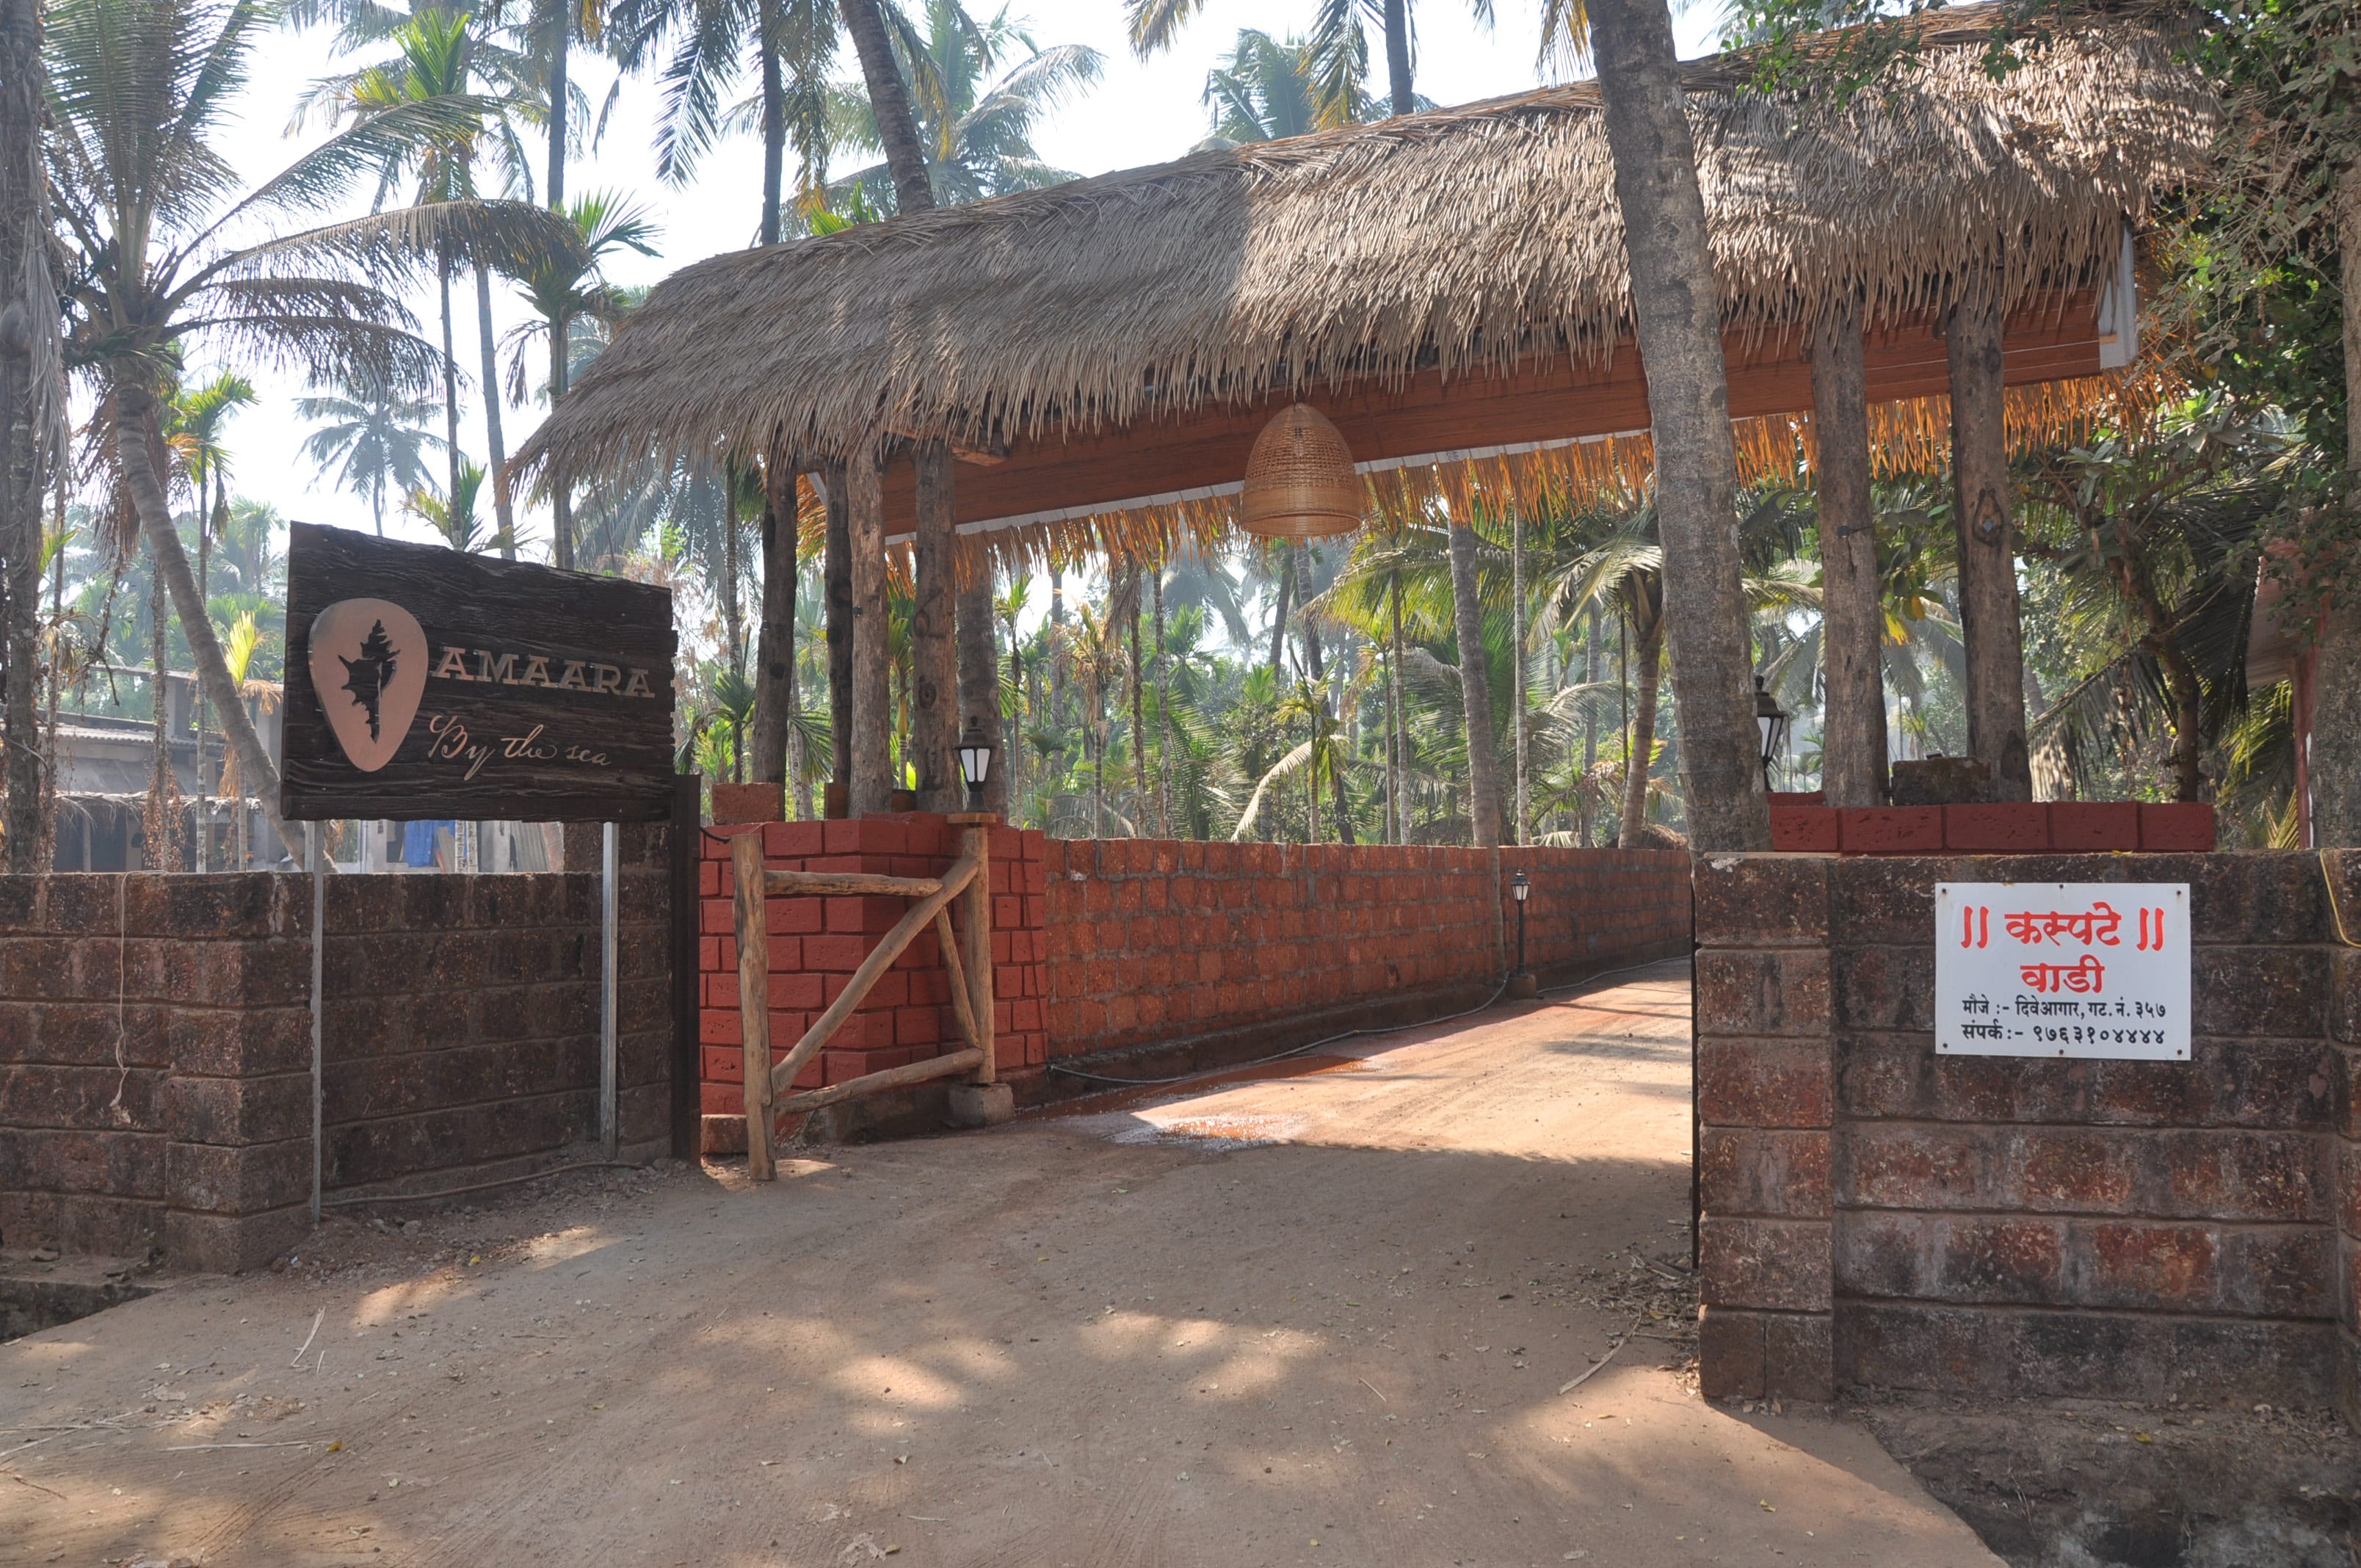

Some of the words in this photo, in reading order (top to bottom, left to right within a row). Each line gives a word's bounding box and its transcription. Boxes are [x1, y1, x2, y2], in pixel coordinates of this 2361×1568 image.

[431, 646, 656, 698] AMAARA
[428, 714, 495, 782] By
[500, 724, 558, 759] the
[565, 744, 612, 766] sea
[2003, 901, 2123, 947] कस्पटे
[2020, 954, 2106, 993] वाडी
[2135, 1001, 2166, 1018] ३५७
[2033, 1025, 2165, 1045] ९७६३१०४४४४
